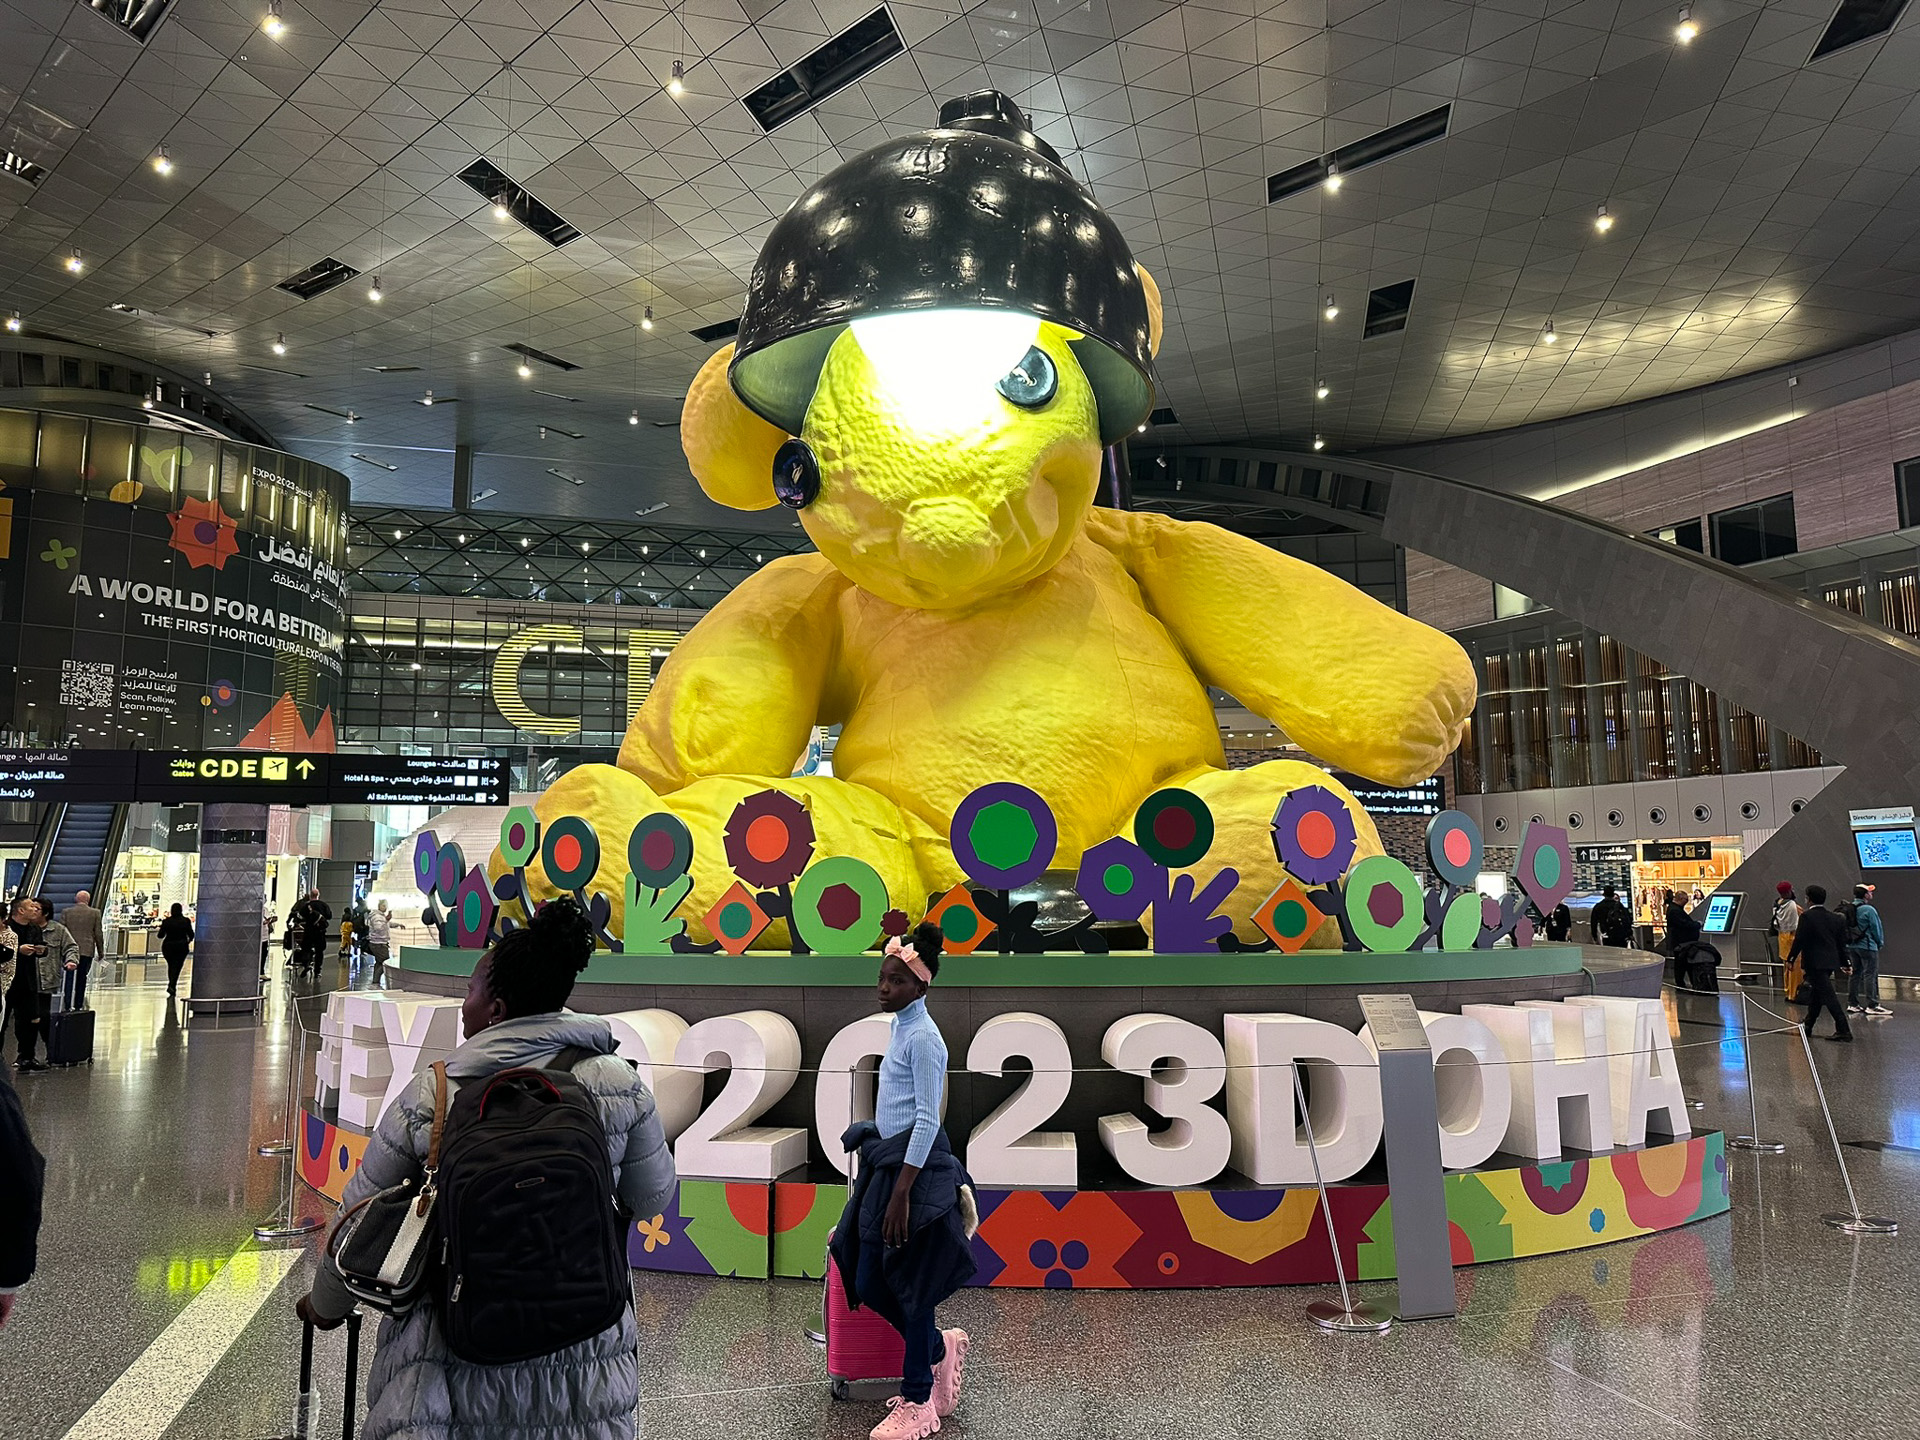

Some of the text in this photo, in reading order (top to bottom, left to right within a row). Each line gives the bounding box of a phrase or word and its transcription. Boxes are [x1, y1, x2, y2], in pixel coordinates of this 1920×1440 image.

[252, 466, 276, 482] EXPO
[68, 573, 93, 597] A
[99, 576, 209, 613] WORLD
[213, 596, 259, 625] FOR
[261, 608, 276, 629] A
[279, 602, 328, 648] BETTER
[141, 612, 174, 629] THE
[175, 618, 218, 635] FIRST
[219, 625, 306, 657] HORTICULTURAL
[306, 646, 324, 663] EXPO
[148, 670, 178, 680] امسح
[153, 681, 177, 694] تابعنا
[120, 691, 177, 706] Scan, Follow,
[119, 701, 146, 711] Learn
[47, 753, 68, 761] صالة
[199, 758, 258, 778] CDE
[407, 759, 437, 769] Lounges
[441, 759, 467, 768] صالات
[44, 770, 66, 780] صالة
[171, 769, 195, 778] Gates
[343, 774, 385, 784] Hotel & Spa
[389, 775, 412, 786] صحي
[433, 775, 453, 786] فندق
[20, 788, 36, 798] ركن
[367, 792, 424, 803] Al Safwa Lounge
[456, 794, 474, 802] صالة
[1674, 845, 1683, 858] B
